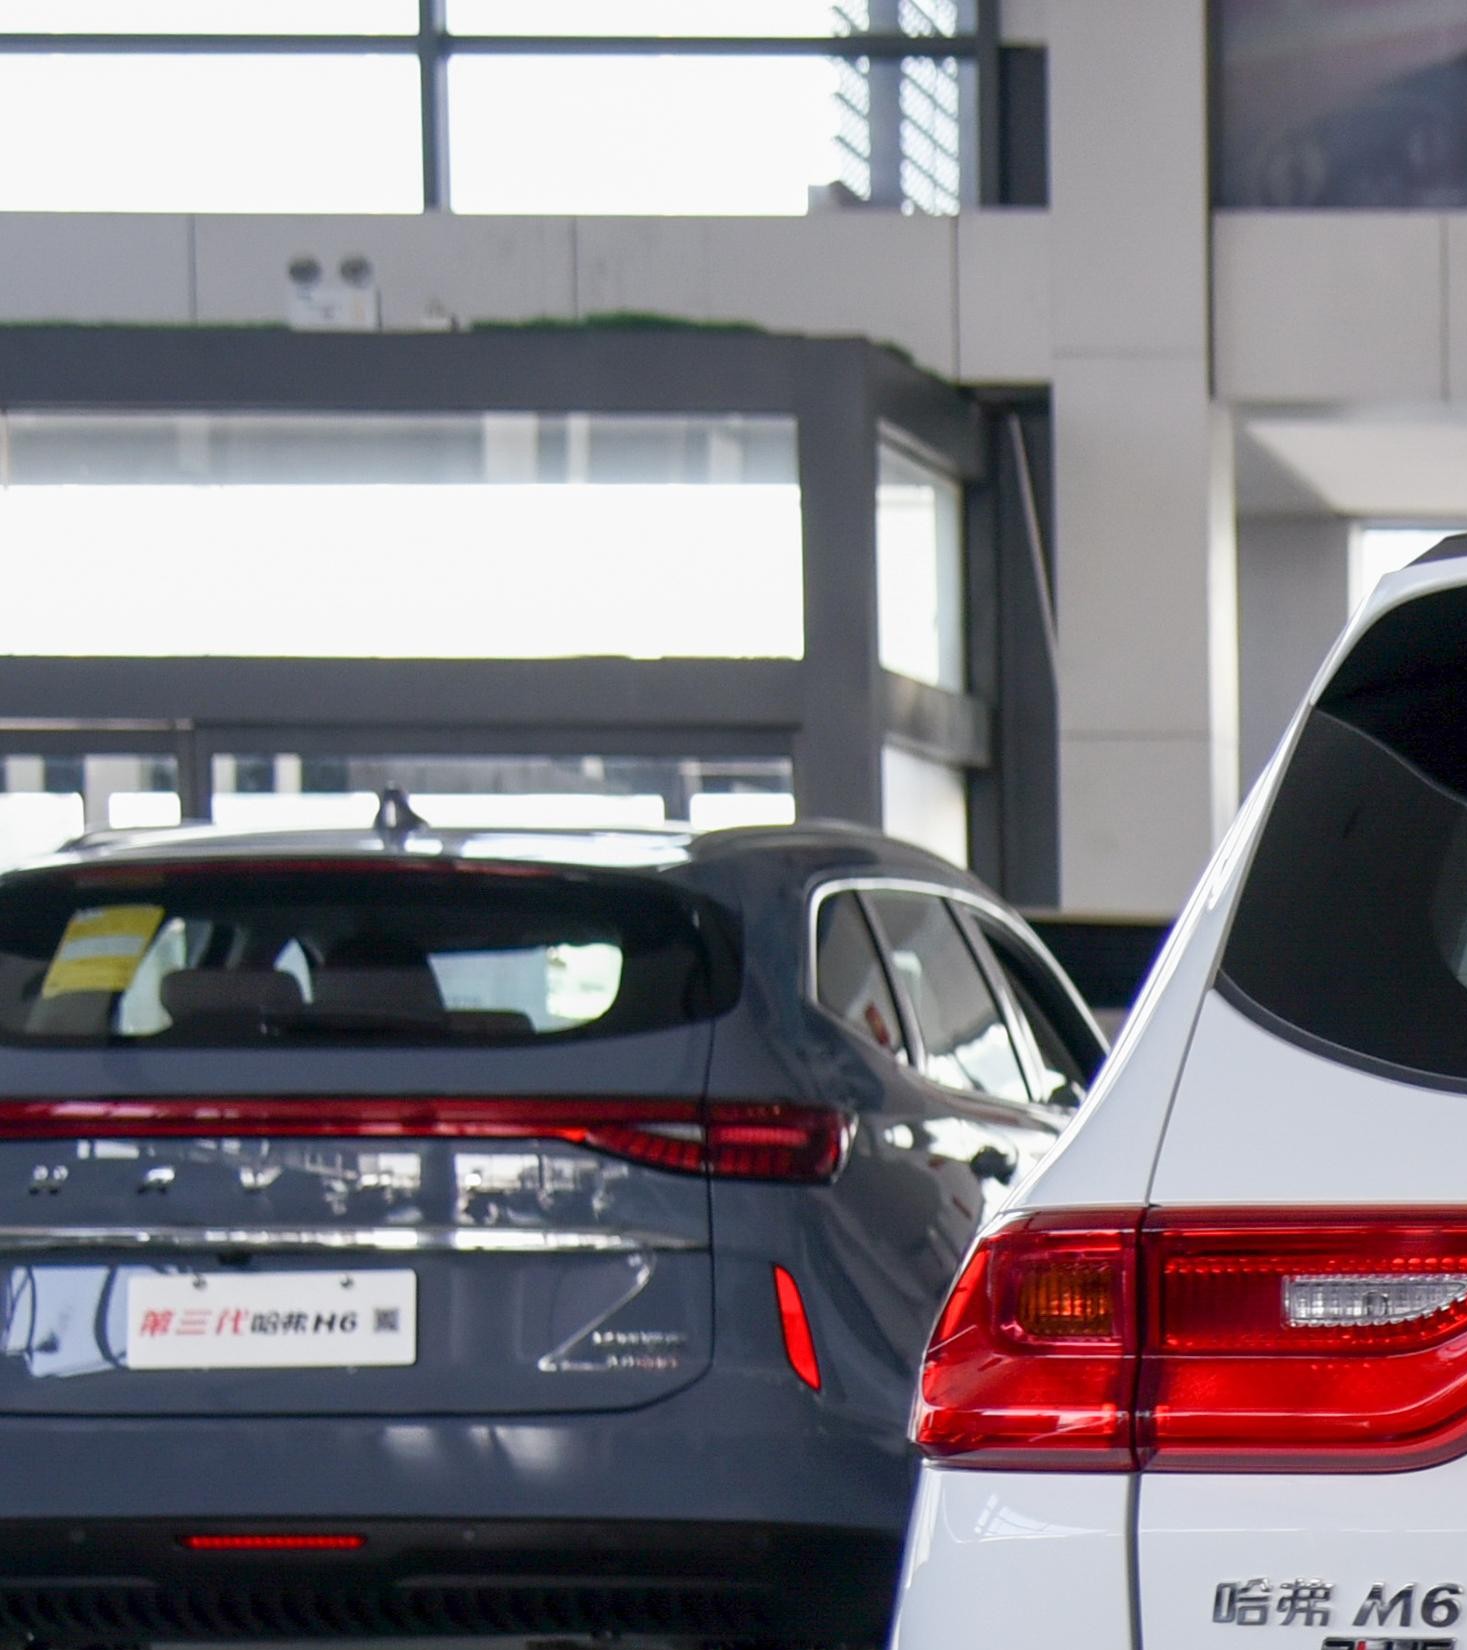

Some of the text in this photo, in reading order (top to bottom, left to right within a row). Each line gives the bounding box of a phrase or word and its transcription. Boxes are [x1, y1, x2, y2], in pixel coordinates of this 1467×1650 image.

[139, 1307, 359, 1338] 第三代哈弗H6
[1212, 1577, 1465, 1628] 哈弗 M6
